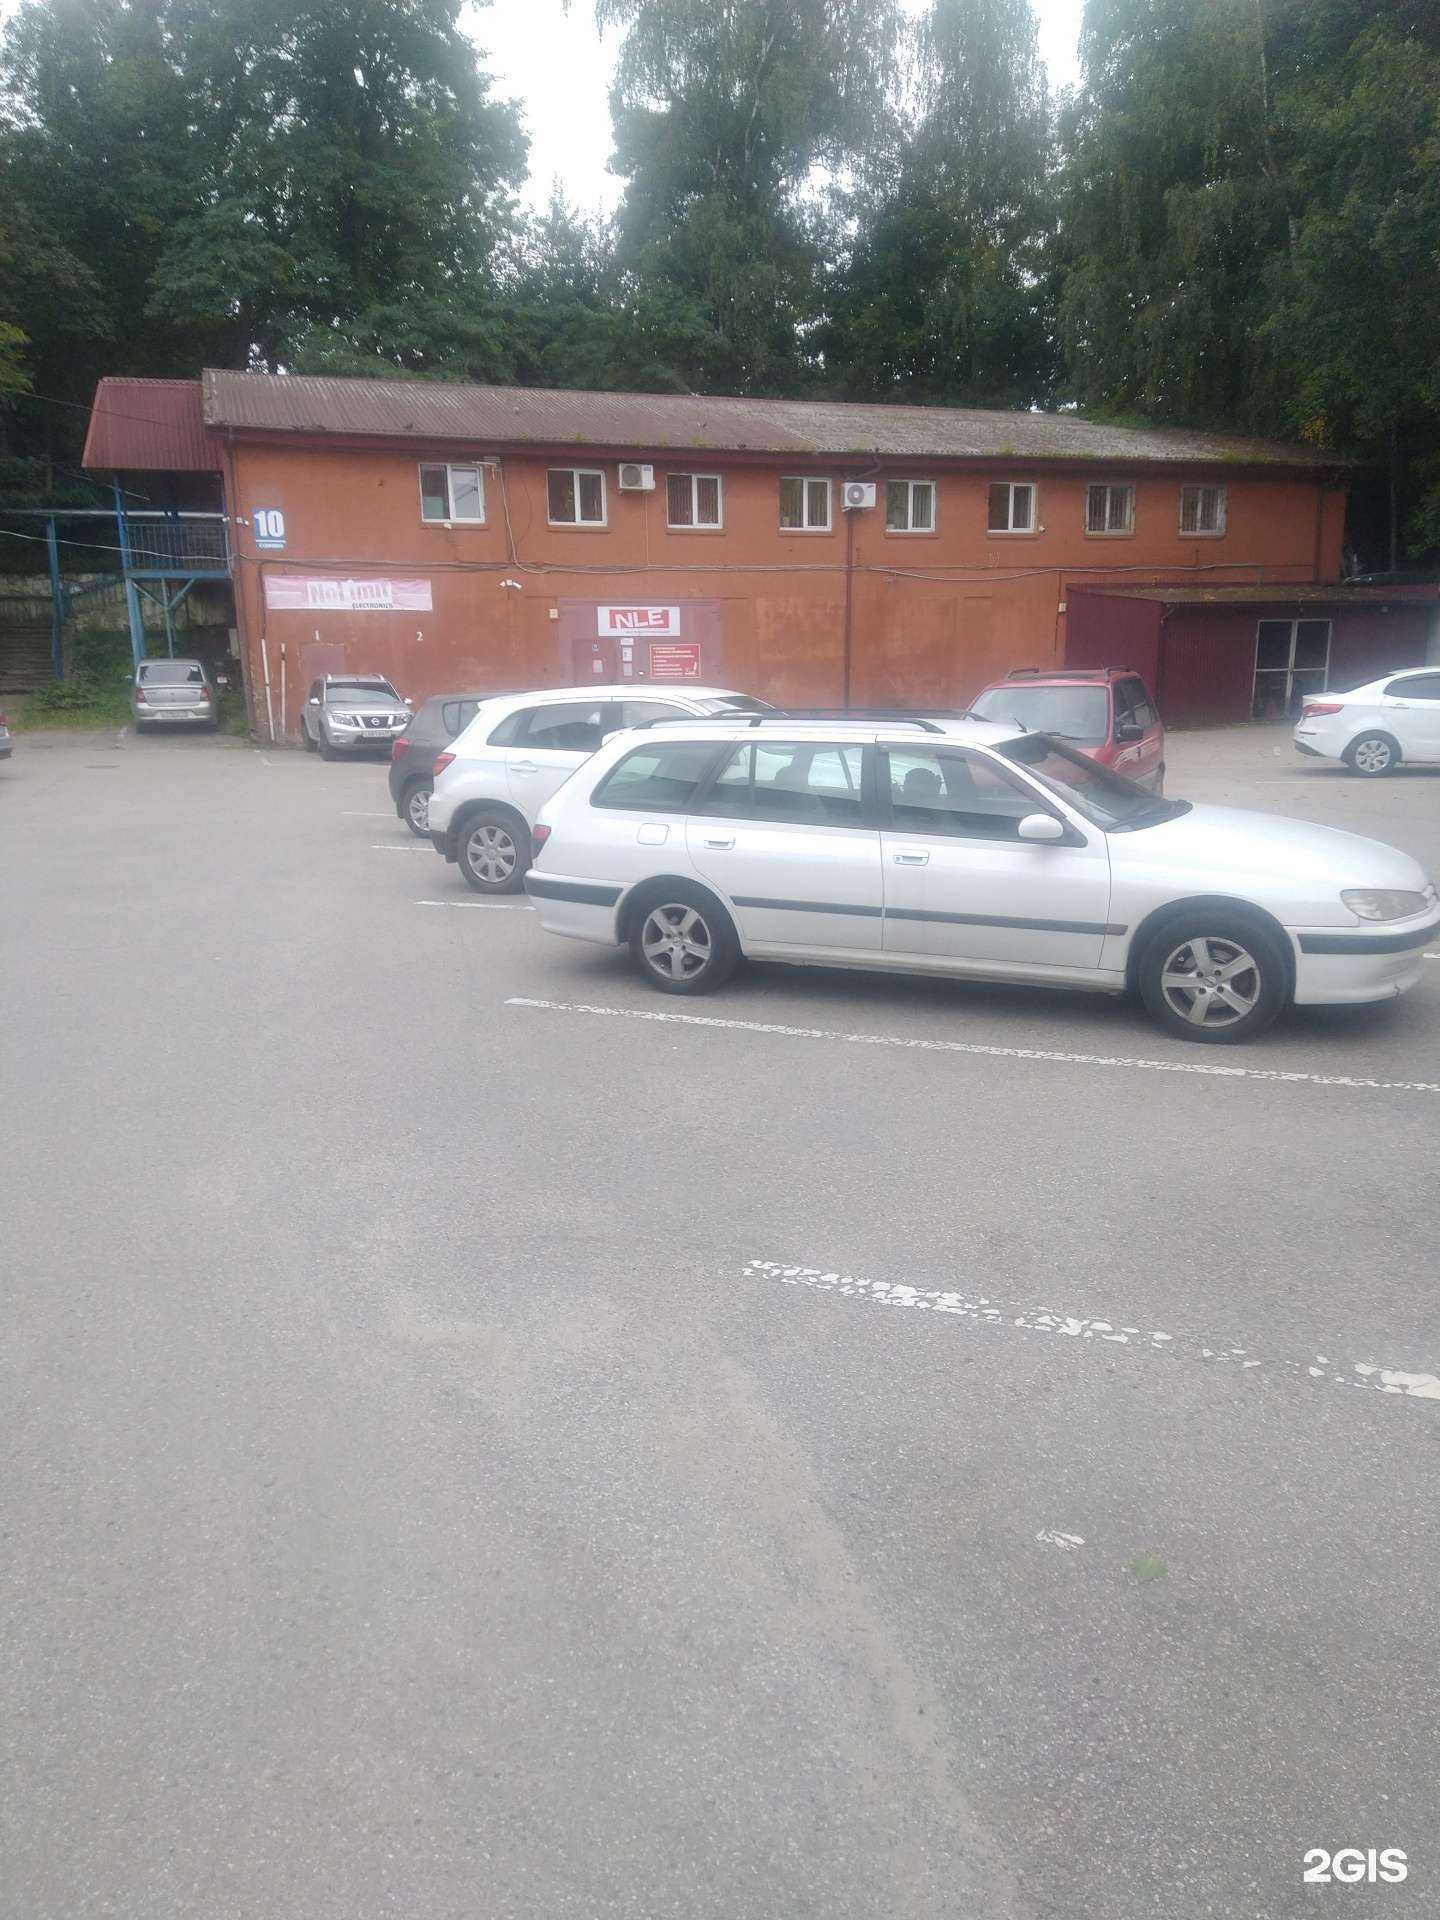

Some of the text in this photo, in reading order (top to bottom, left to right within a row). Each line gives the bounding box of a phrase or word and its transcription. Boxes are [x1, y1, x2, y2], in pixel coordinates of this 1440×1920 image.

[254, 510, 285, 537] 10
[615, 609, 664, 629] NLE
[416, 631, 424, 641] 2
